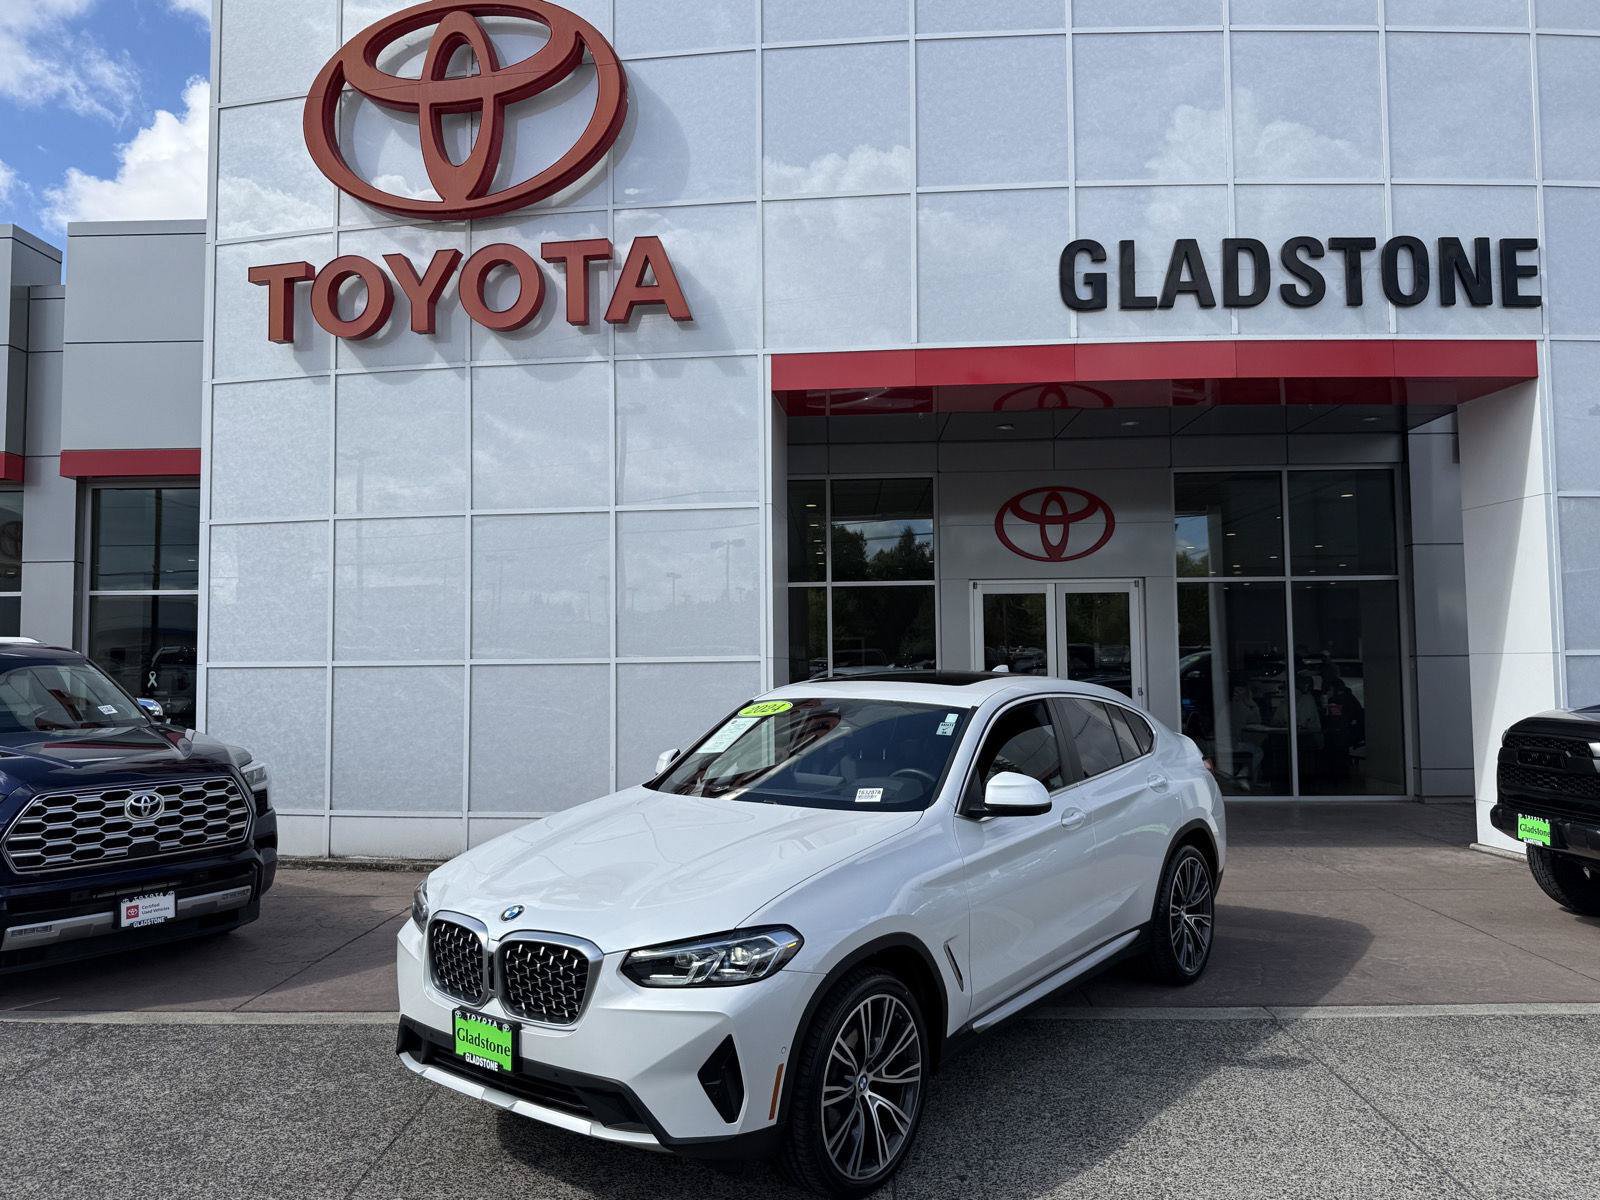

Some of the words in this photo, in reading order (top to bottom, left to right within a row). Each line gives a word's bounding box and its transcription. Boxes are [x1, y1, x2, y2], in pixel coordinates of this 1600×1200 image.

[1059, 236, 1543, 311] GLADSTONE
[248, 236, 694, 344] TOYOTA
[751, 703, 787, 714] 2024
[133, 892, 164, 901] TOYOTA
[133, 916, 165, 928] GLADSTONE
[466, 1013, 498, 1028] TOYOTA
[457, 1027, 511, 1057] Gladstone
[465, 1053, 499, 1071] GLADSTONE
